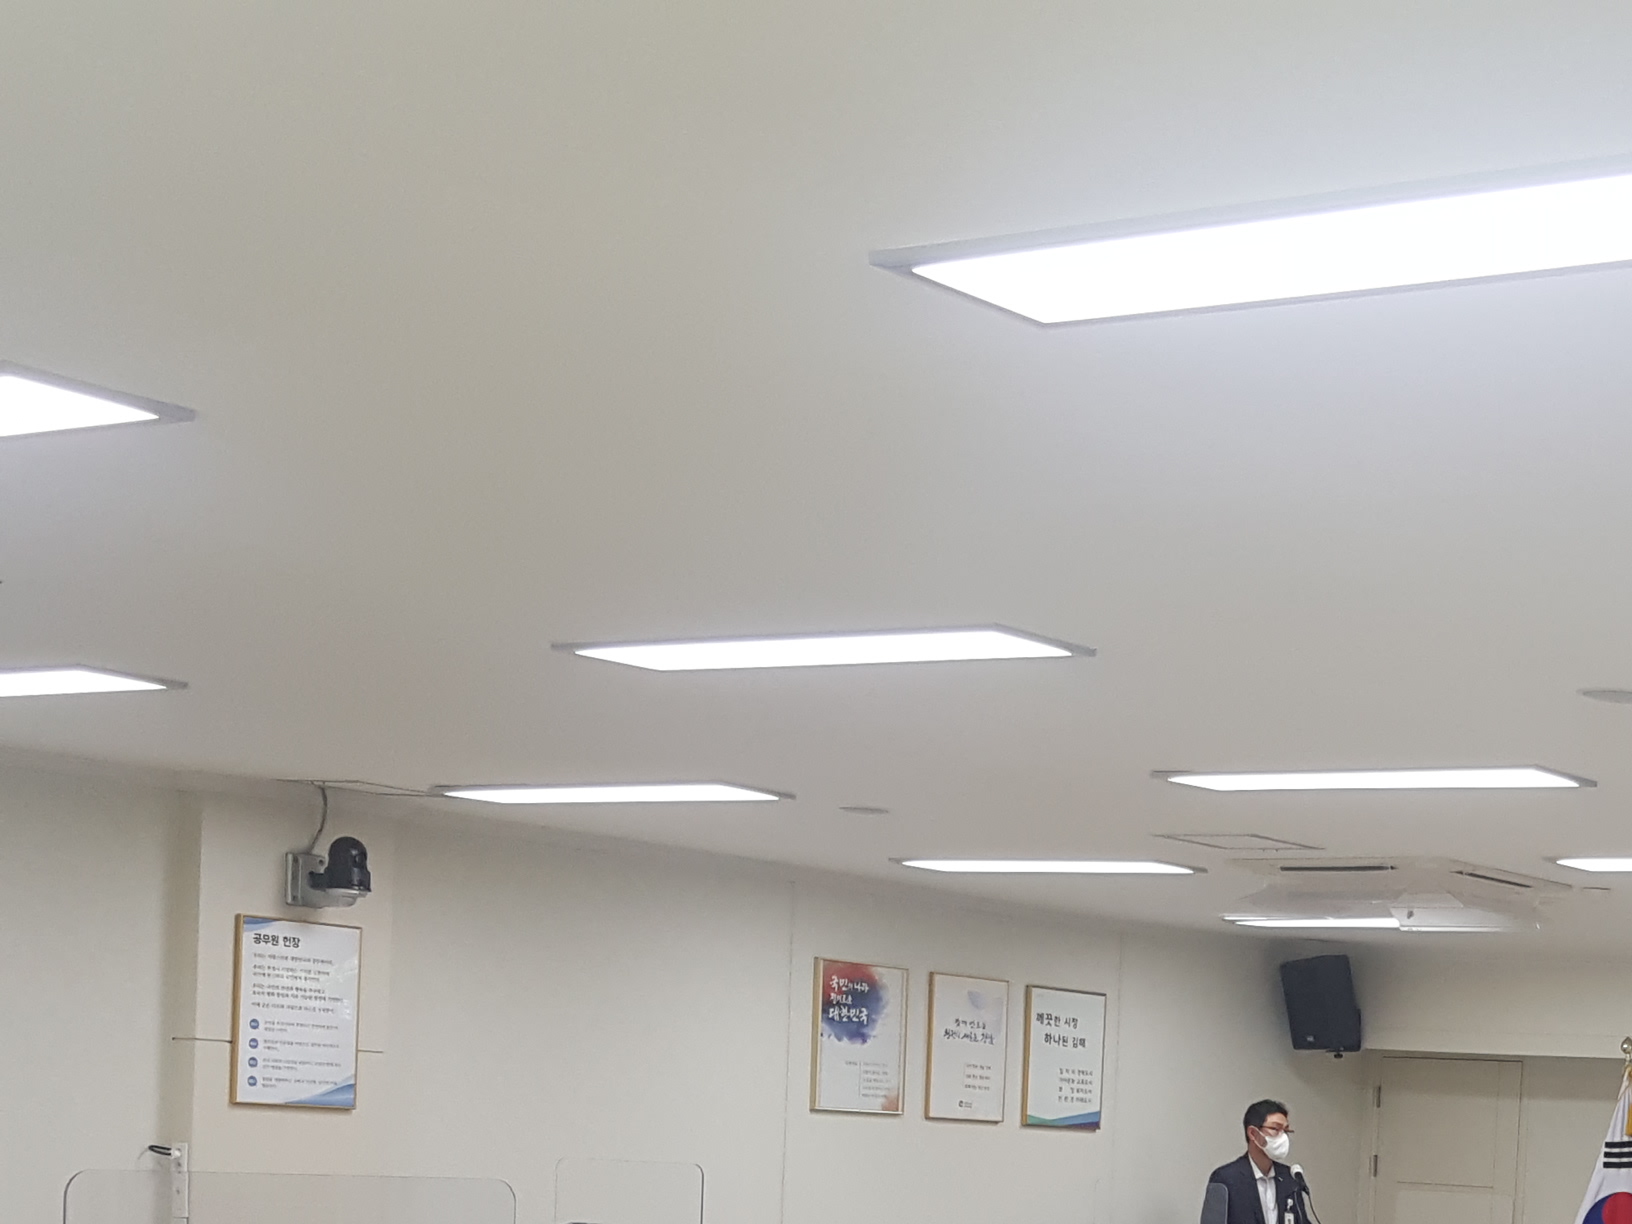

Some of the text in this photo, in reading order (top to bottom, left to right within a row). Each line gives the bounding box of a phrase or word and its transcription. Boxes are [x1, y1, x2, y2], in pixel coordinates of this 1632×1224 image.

[252, 933, 301, 949] 공무원 헌장
[828, 1005, 869, 1025] 대한민국
[1035, 1012, 1079, 1029] 깨끗한 시정
[1044, 1033, 1087, 1049] 하나된 김해
